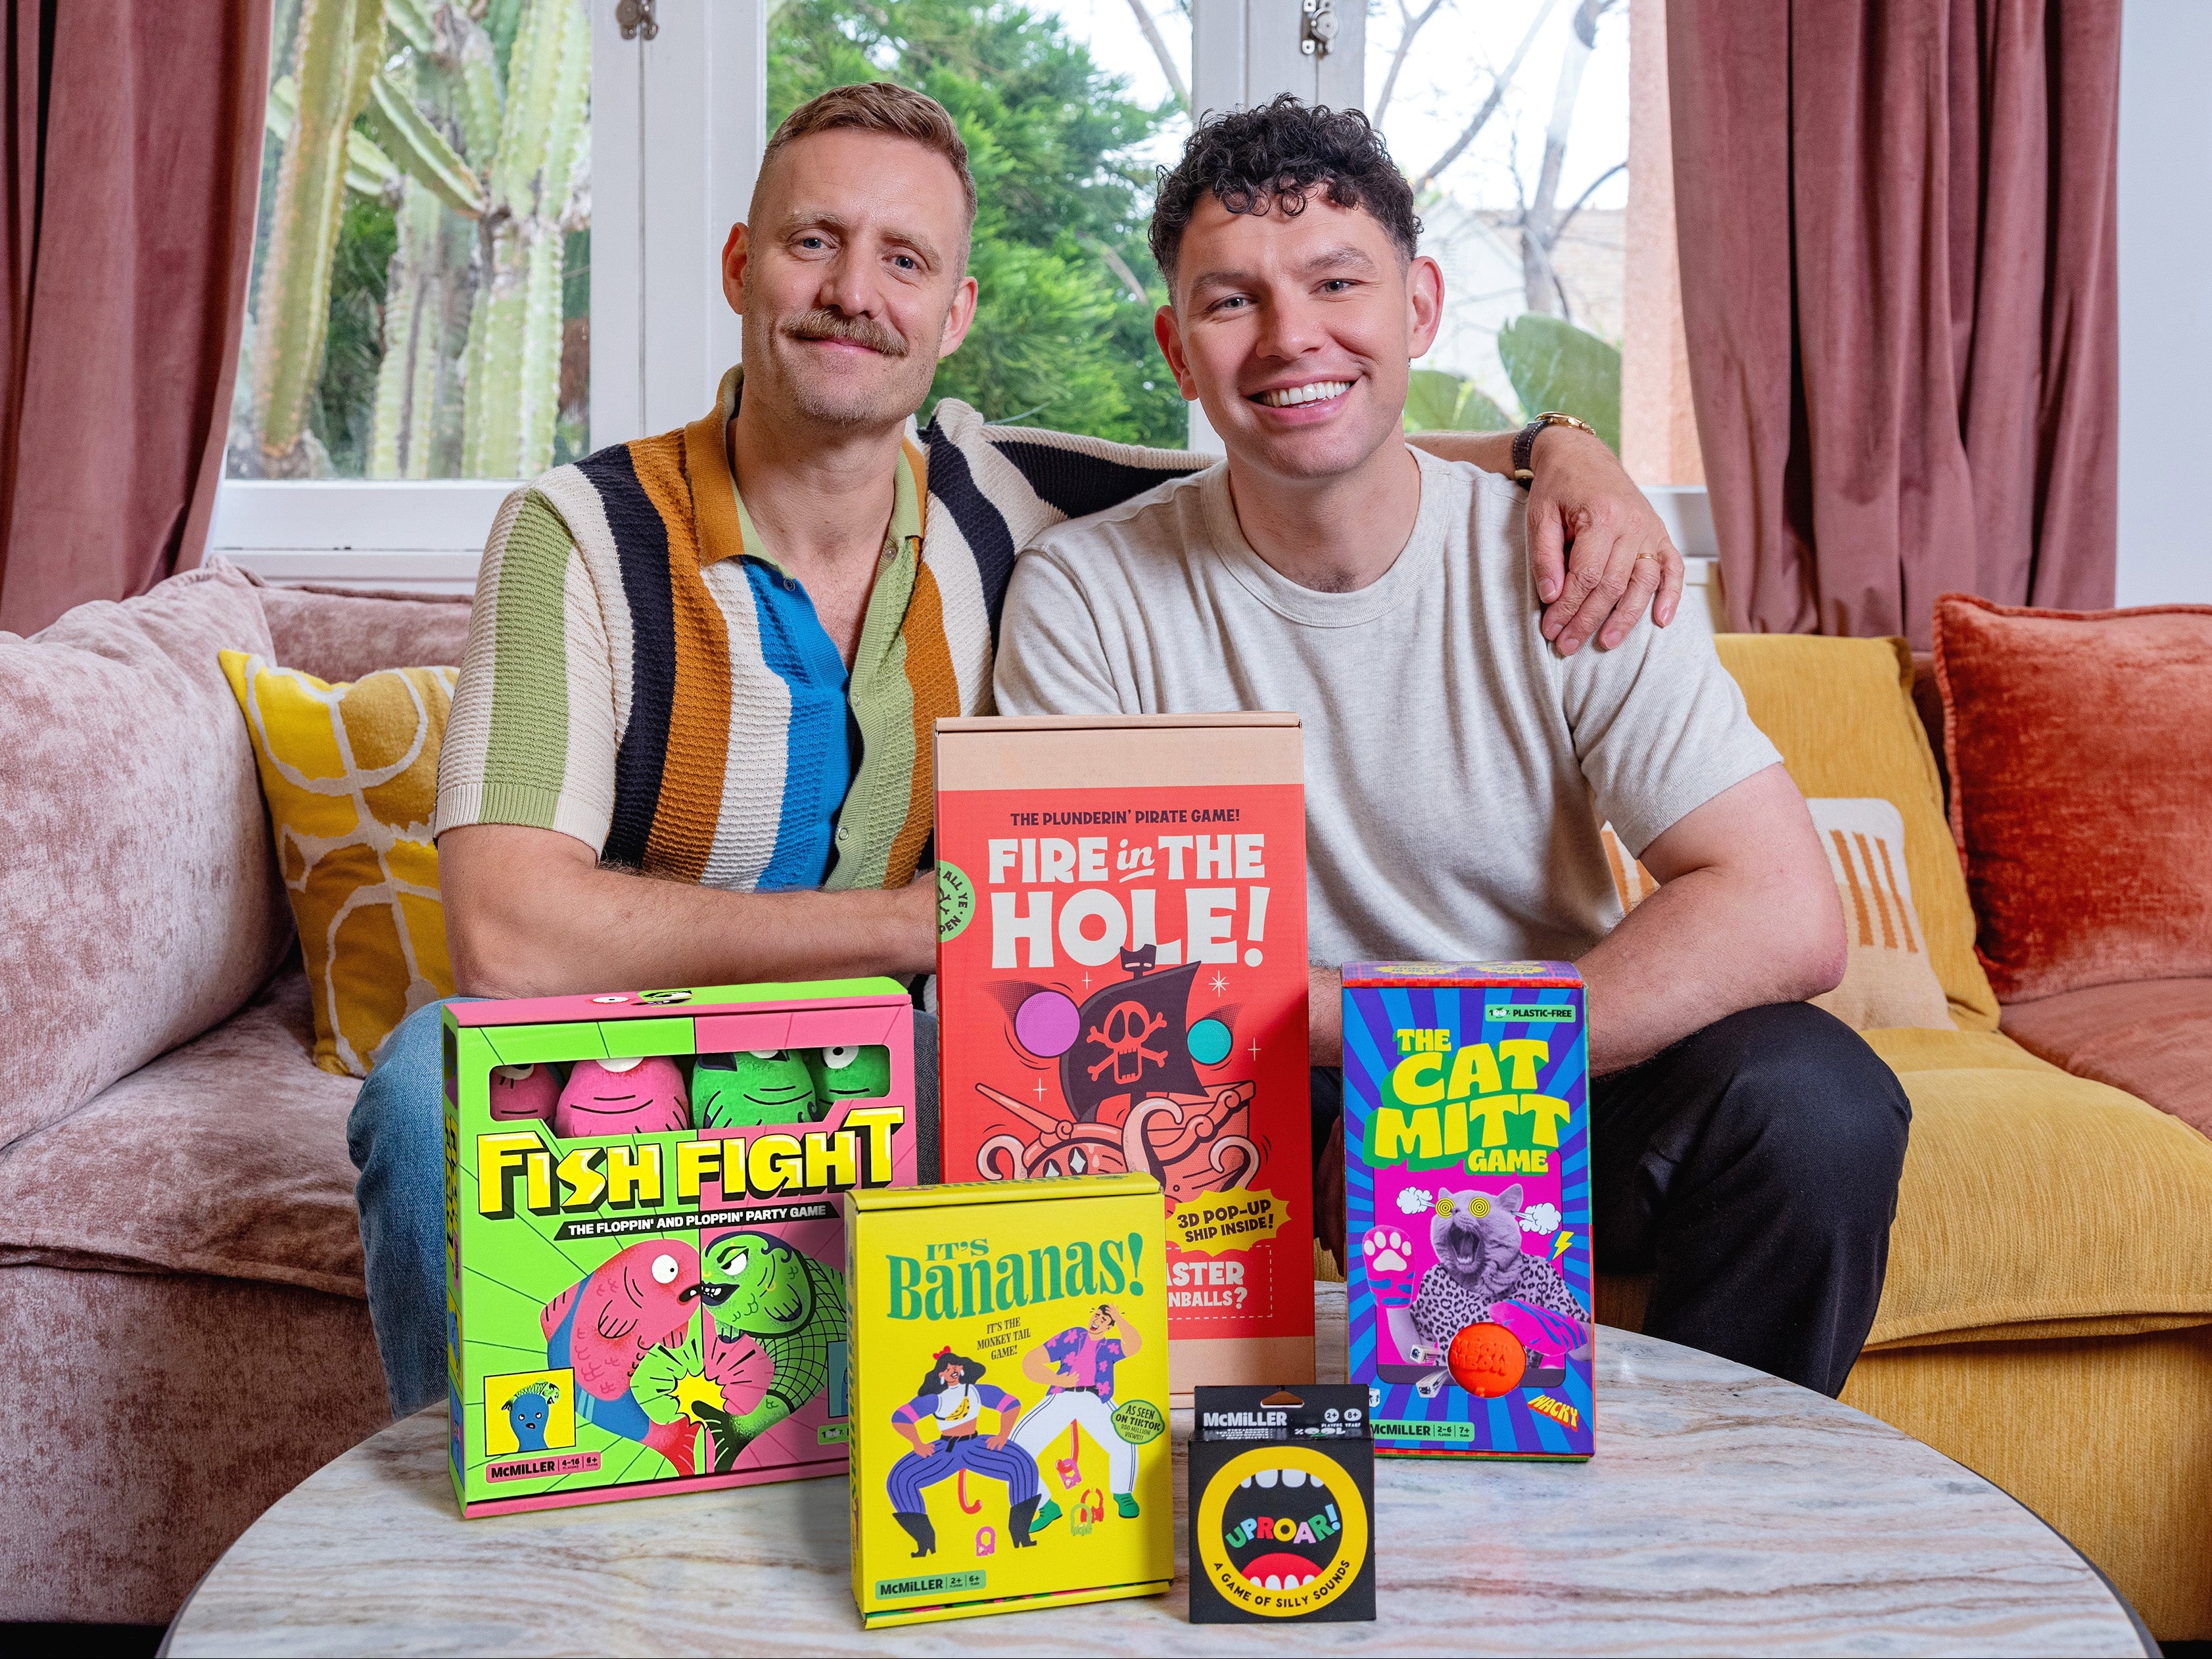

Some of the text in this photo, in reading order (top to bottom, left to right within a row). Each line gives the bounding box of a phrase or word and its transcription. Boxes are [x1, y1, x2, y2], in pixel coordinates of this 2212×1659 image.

[1011, 812, 1039, 827] THE
[1135, 809, 1187, 825] PIRATE
[1190, 808, 1240, 824] GAME!
[988, 833, 1266, 884] FIRE in THE
[943, 870, 968, 908] ALL YE
[990, 885, 1271, 970] HOLE!
[1395, 1029, 1451, 1052] THE
[1391, 1039, 1549, 1106] CAT
[1374, 1094, 1571, 1160] MITT
[477, 1106, 905, 1221] FISH FIGHT
[1467, 1149, 1549, 1173] GAME
[568, 1205, 826, 1236] THE FLOPPIN' AND PLOPPIN' PARTY GAME
[1177, 1199, 1271, 1229] 3D POP-UP
[1185, 1213, 1274, 1243] SHIP INSIDE!
[885, 1232, 1144, 1322] Bananas!
[1004, 1317, 1021, 1330] THE
[976, 1328, 1031, 1351] MONKEY TAIL
[990, 1345, 1018, 1361] GAME!
[1116, 1414, 1160, 1431] ON TIKTOK
[1126, 1405, 1155, 1420] AS SEEN
[1527, 1395, 1579, 1432] WACKY
[562, 1457, 580, 1466] 4-16
[1225, 1503, 1341, 1549] UPROAR!
[1213, 1560, 1350, 1608] A GAME OF SILLY SOUNDS
